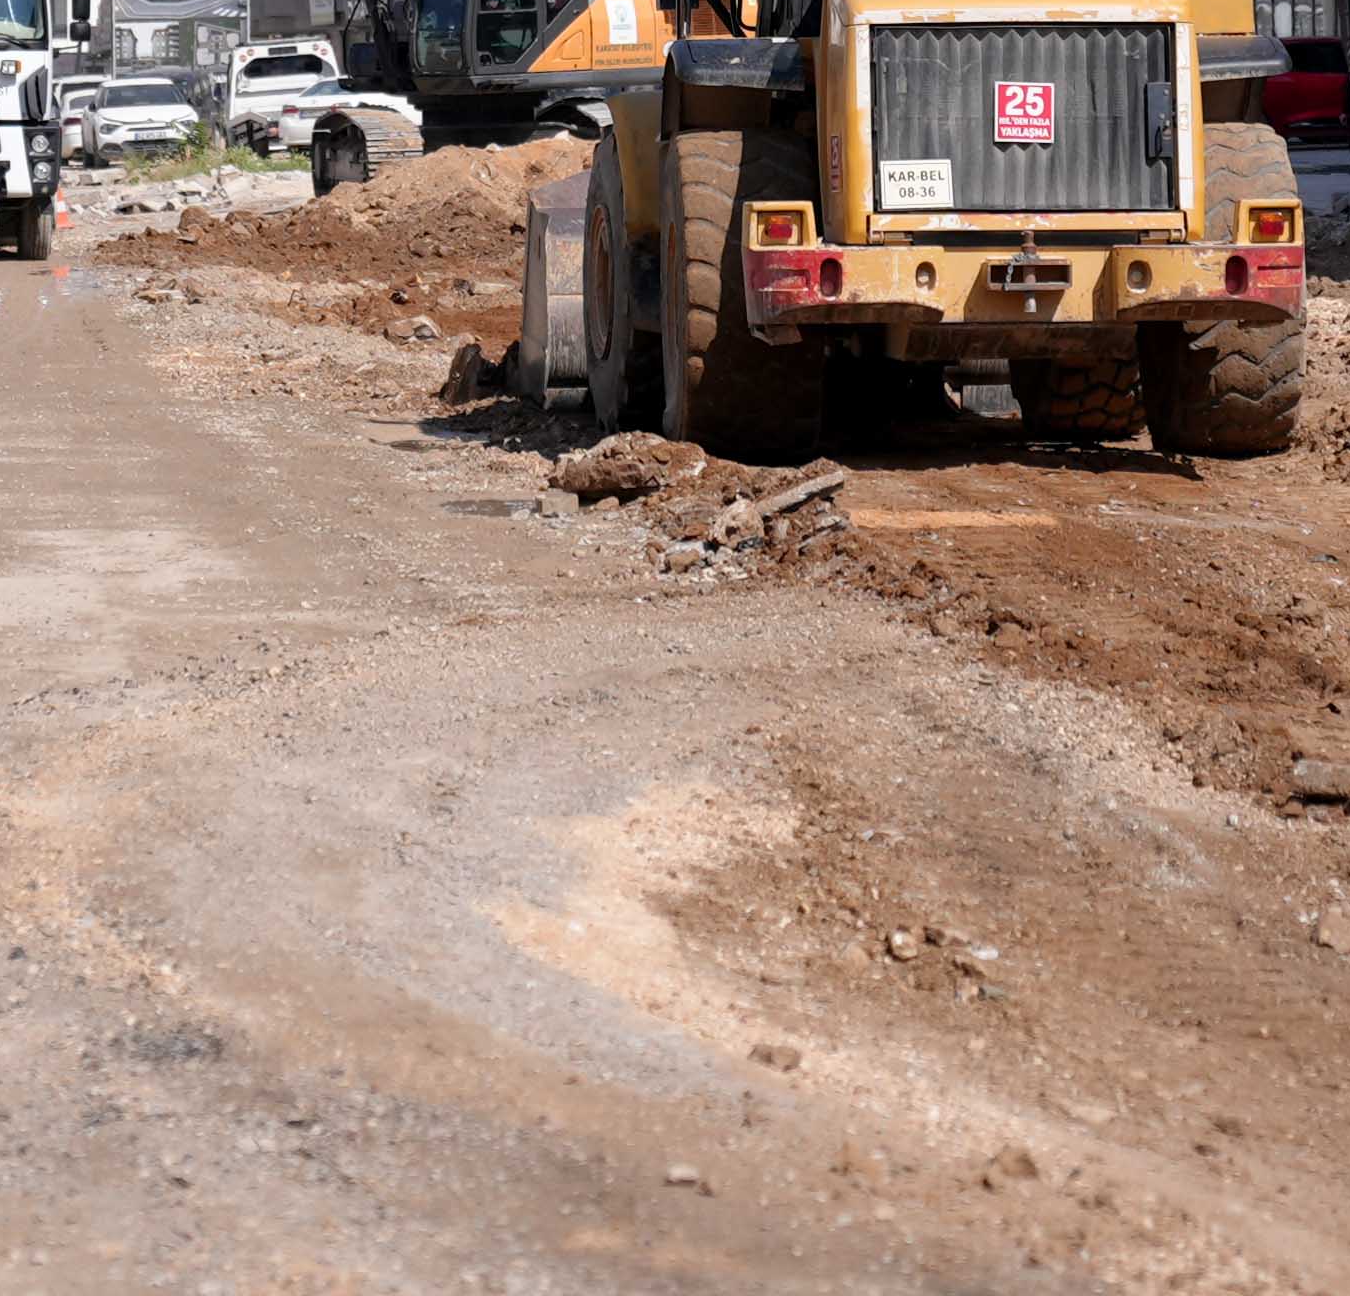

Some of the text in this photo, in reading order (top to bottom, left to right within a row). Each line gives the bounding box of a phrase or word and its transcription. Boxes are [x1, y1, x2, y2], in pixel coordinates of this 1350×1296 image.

[1005, 85, 1045, 117] 25
[1000, 127, 1050, 138] YAKLAŞMA
[888, 170, 945, 182] KAR-BEL
[899, 187, 936, 198] 08-36
